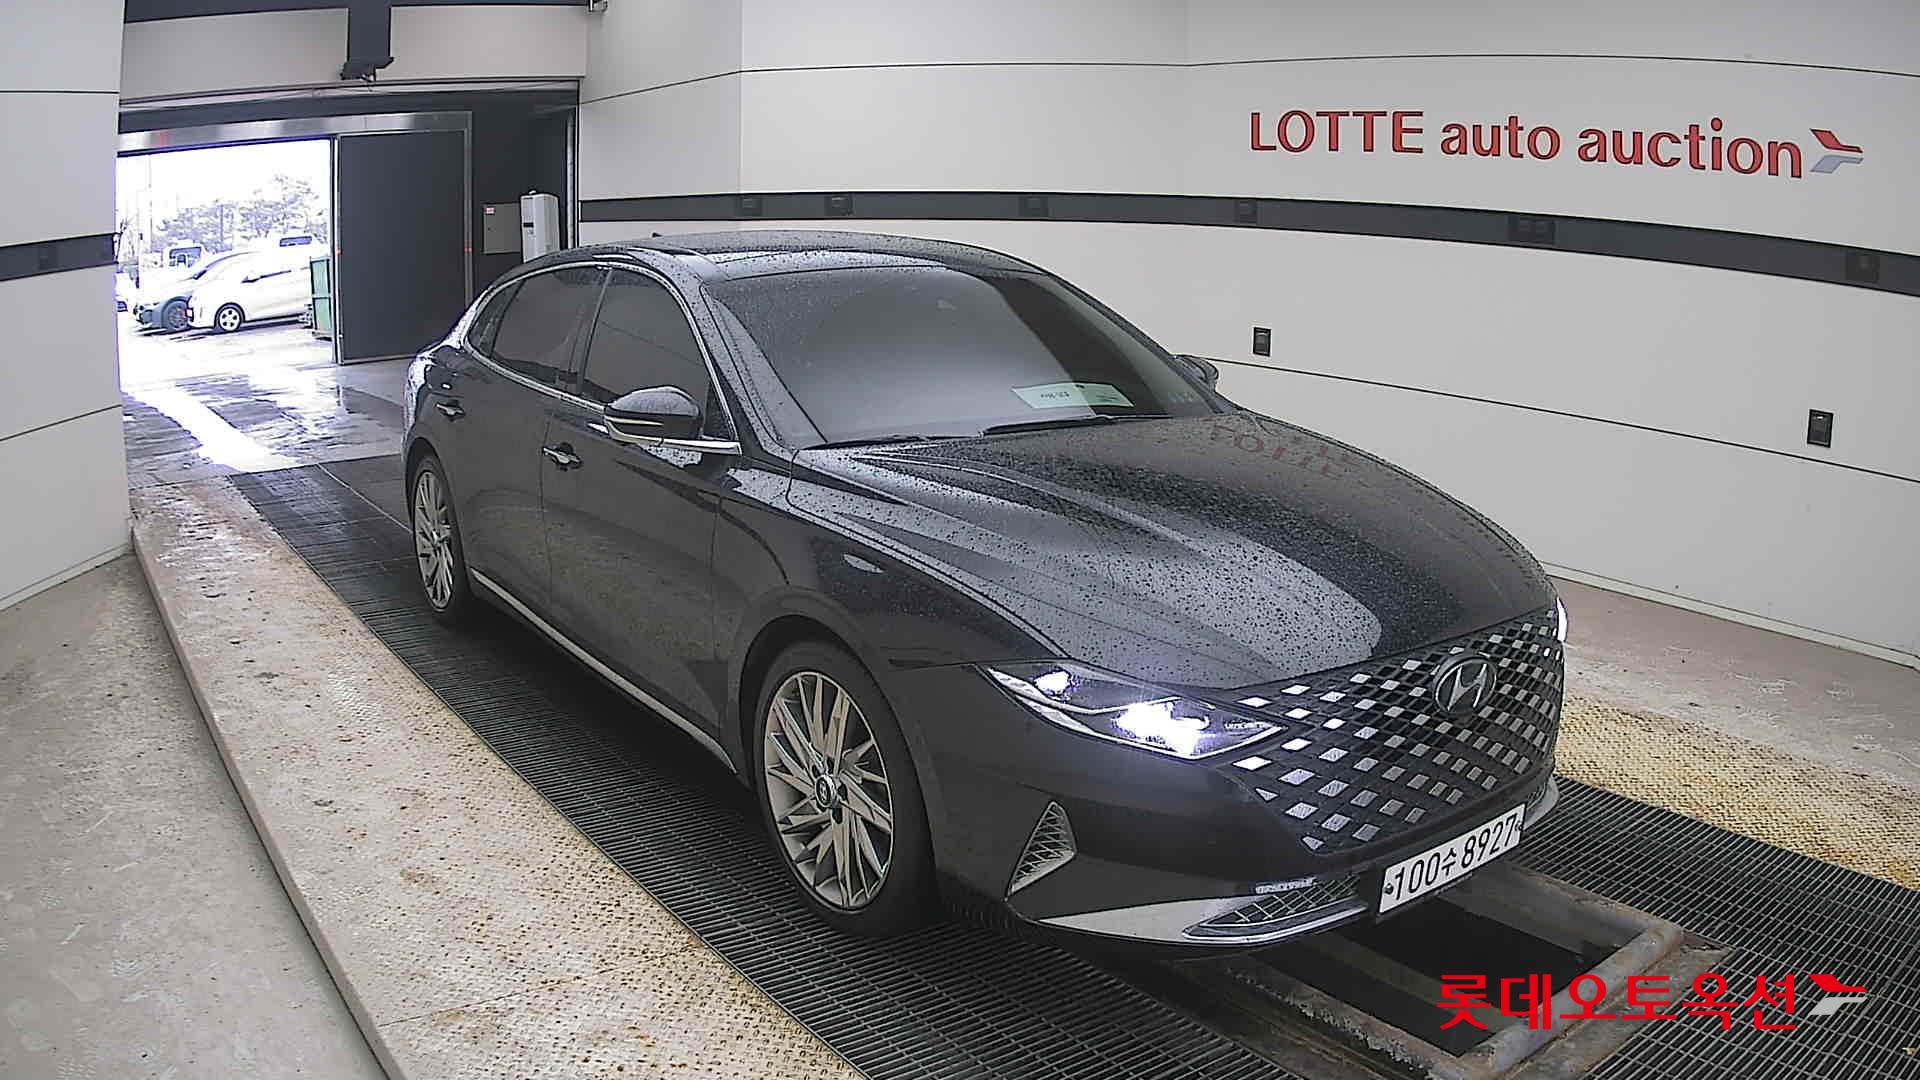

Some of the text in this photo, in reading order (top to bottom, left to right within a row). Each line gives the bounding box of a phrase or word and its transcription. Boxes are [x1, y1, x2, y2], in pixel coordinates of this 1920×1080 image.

[1250, 111, 1803, 178] LOTTE auto auction
[1460, 812, 1518, 869] 8927
